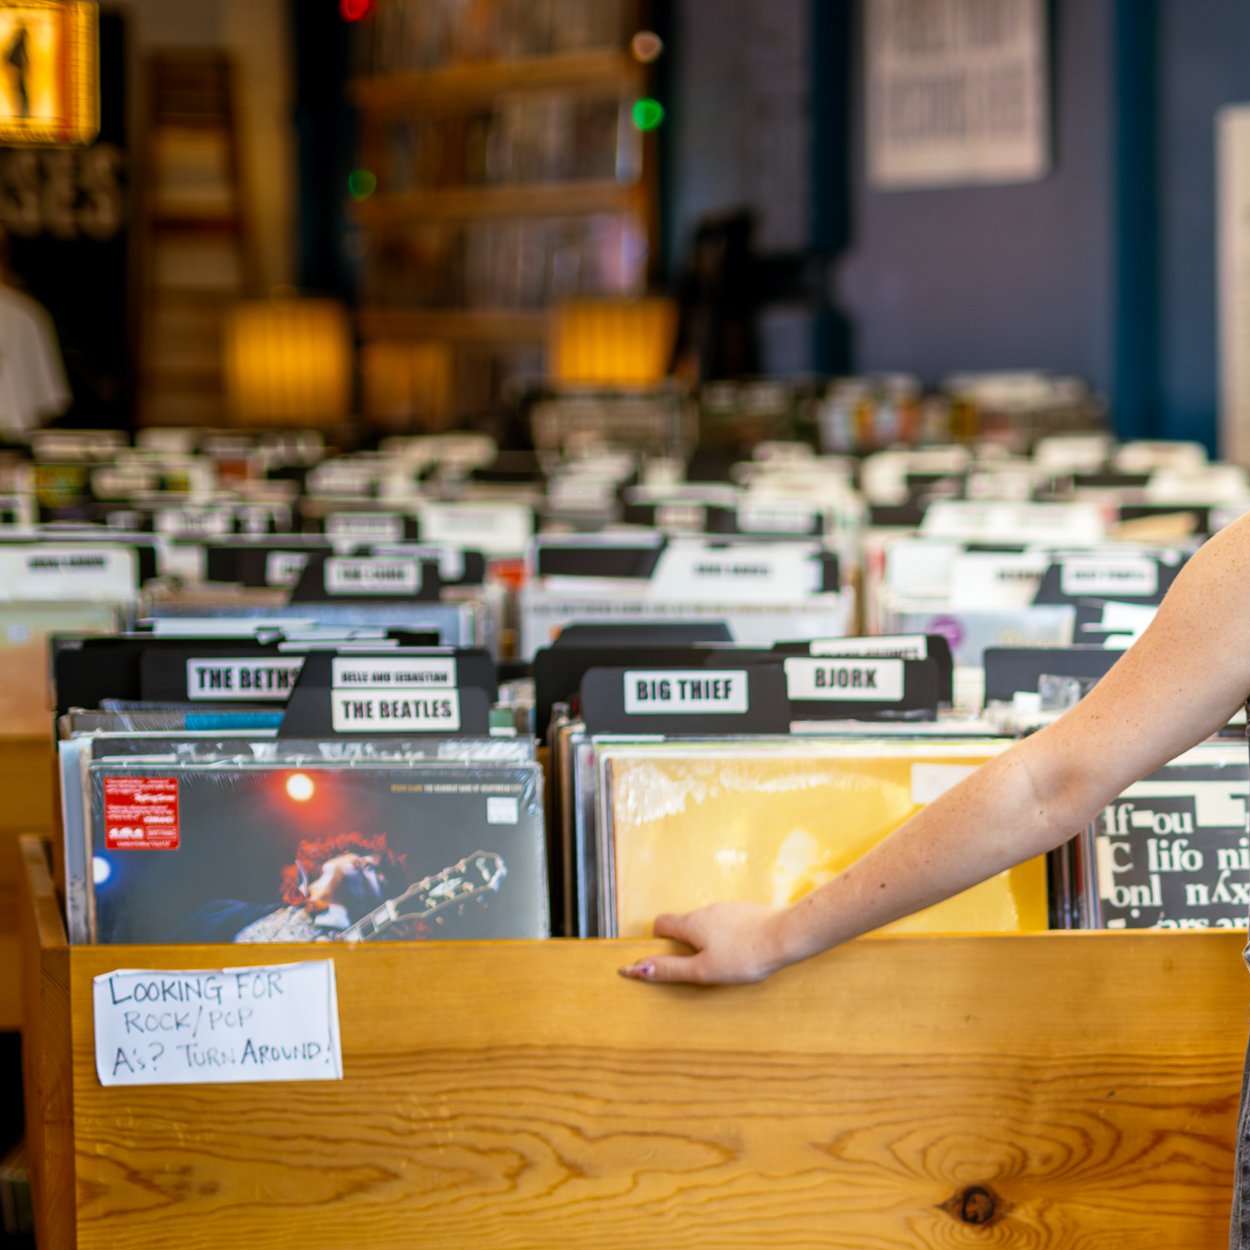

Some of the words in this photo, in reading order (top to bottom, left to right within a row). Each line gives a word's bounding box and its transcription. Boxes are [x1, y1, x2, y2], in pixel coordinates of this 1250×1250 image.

[196, 667, 232, 688] THE
[372, 671, 391, 682] AND
[815, 668, 877, 688] BJORK
[636, 680, 671, 700] BIG
[678, 679, 732, 700] THIEF
[342, 699, 373, 718] THE
[379, 699, 452, 718] BEATLES
[108, 976, 222, 1006] LOOKING
[235, 972, 284, 999] FOR
